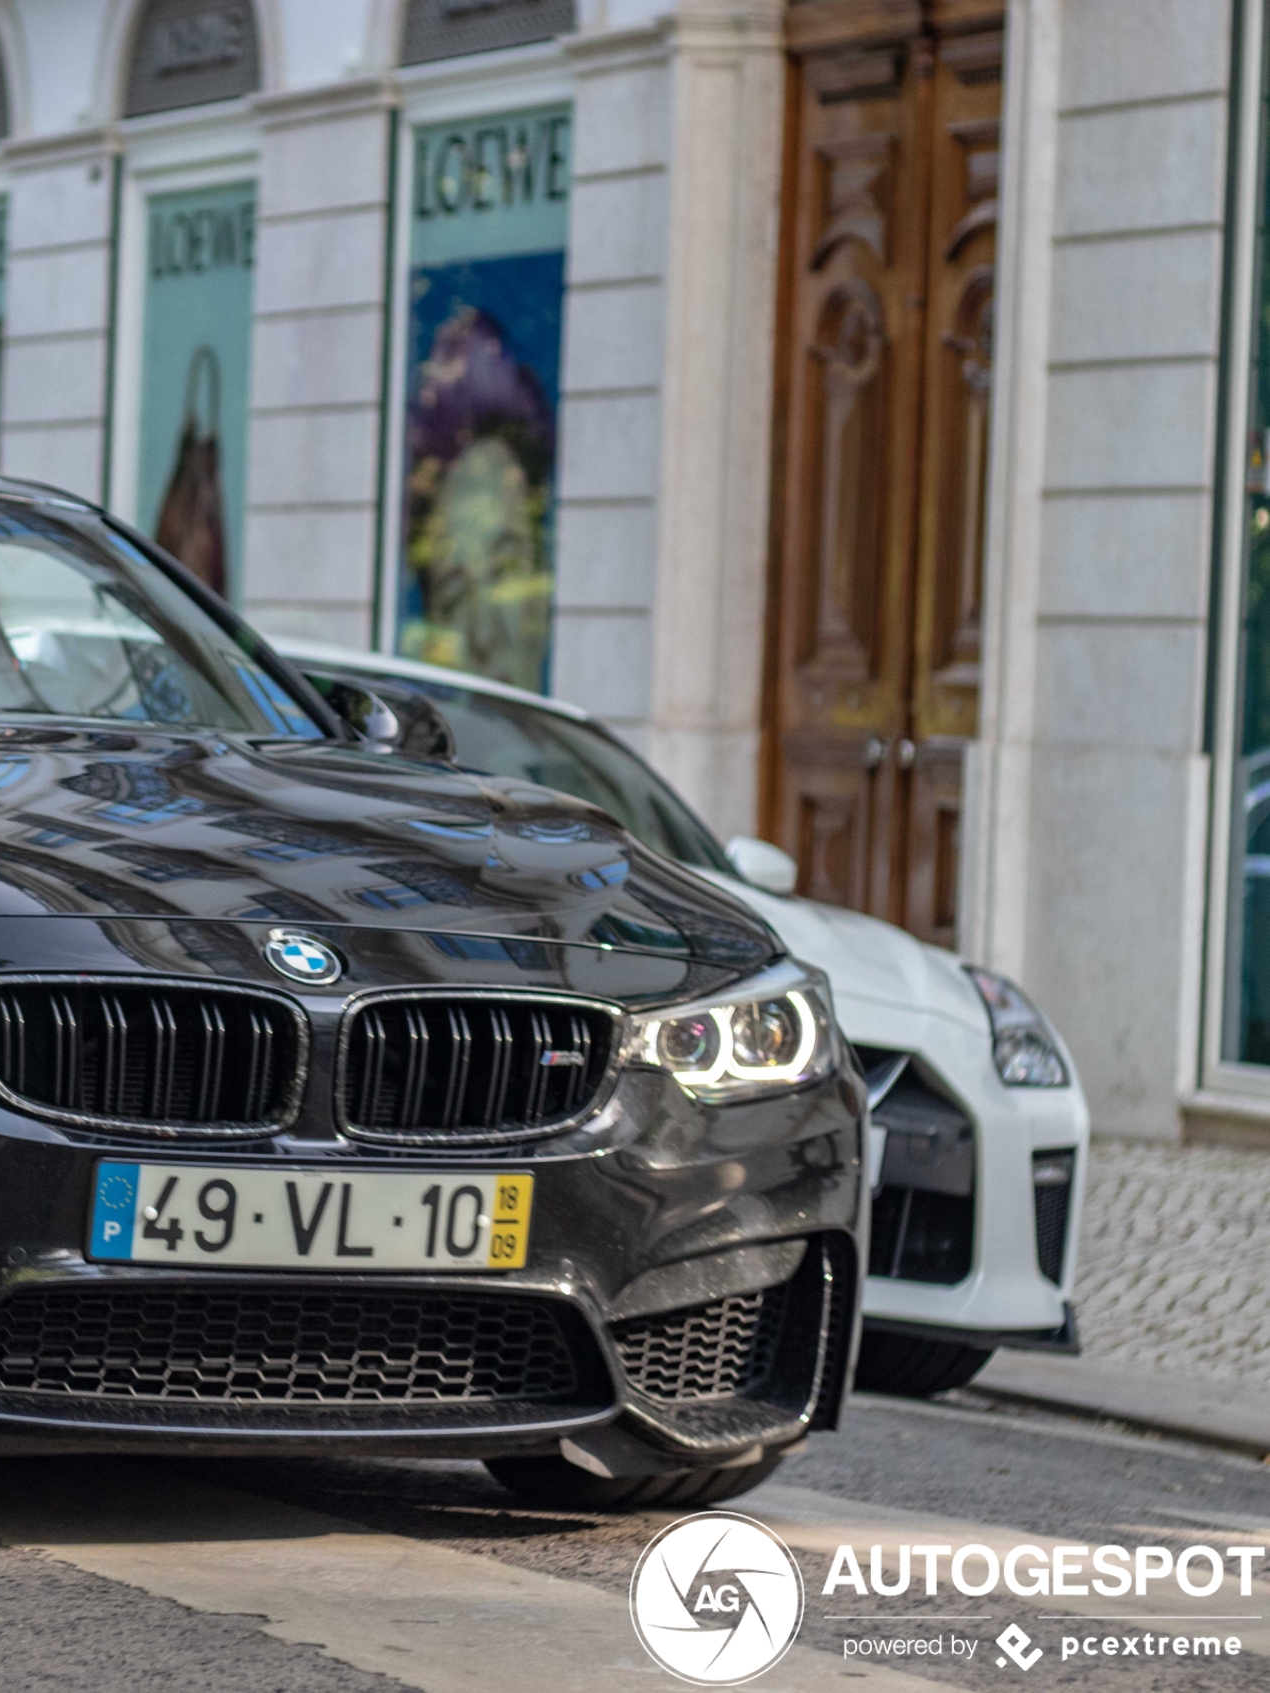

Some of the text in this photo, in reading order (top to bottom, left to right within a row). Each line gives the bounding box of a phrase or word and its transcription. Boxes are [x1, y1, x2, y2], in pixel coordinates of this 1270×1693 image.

[414, 115, 570, 218] LOEWE
[498, 1185, 519, 1211] 18
[103, 1221, 122, 1242] P
[491, 1234, 517, 1259] 09
